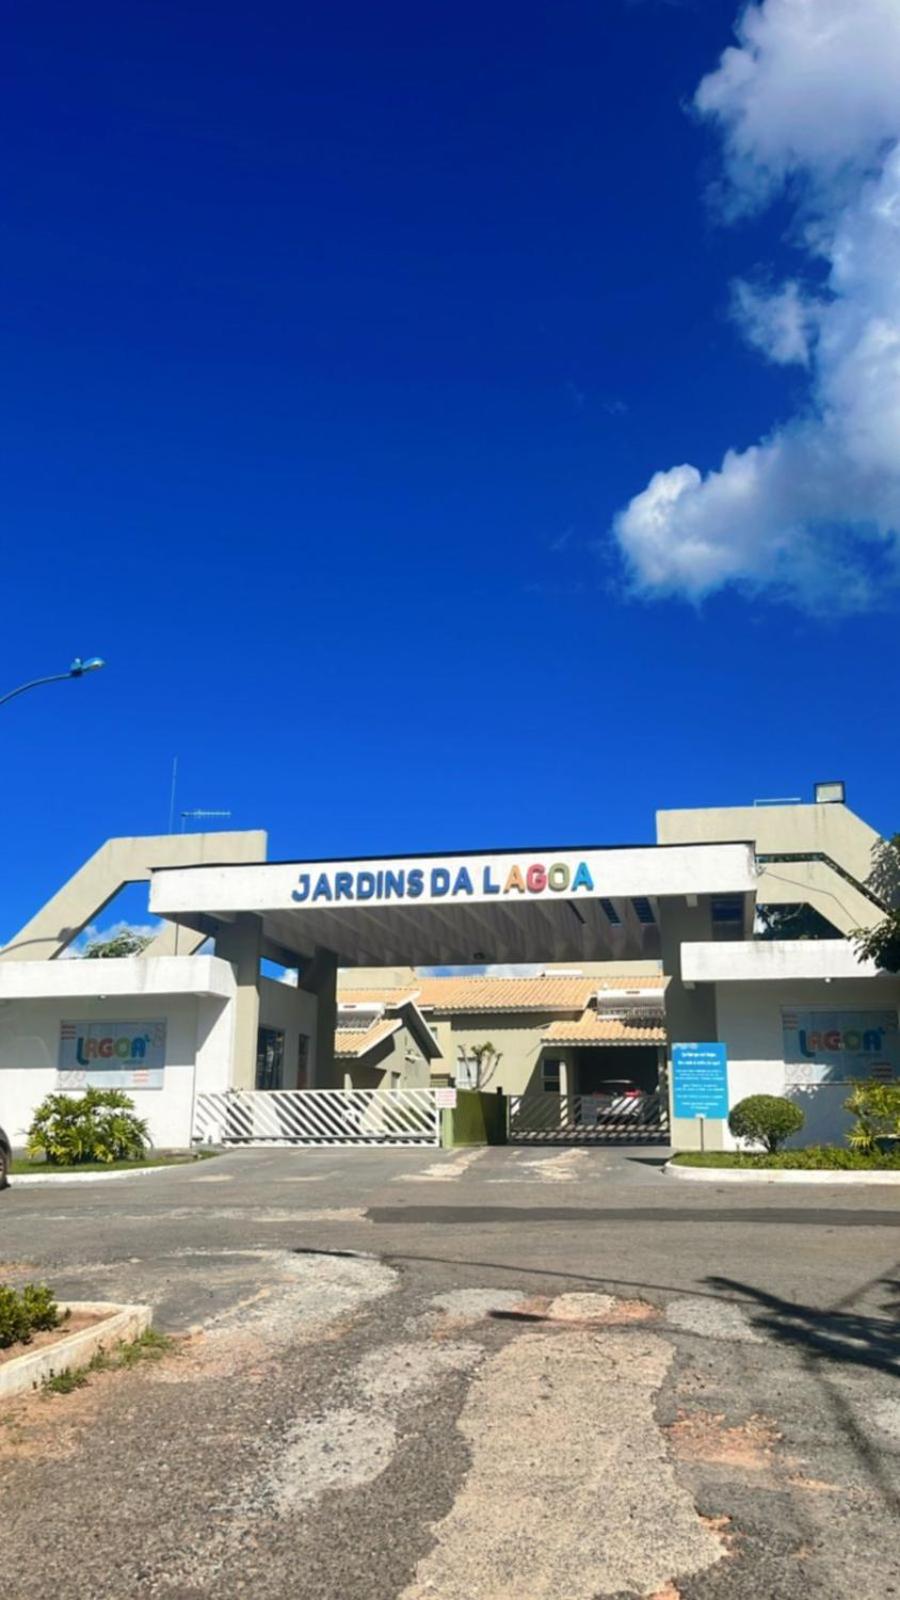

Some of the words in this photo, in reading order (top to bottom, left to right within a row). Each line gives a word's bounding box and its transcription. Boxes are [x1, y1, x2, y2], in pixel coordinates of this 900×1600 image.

[291, 868, 424, 902] JARDINS
[431, 866, 473, 897] DA
[483, 861, 594, 894] LAGOA
[76, 1035, 147, 1065] LAGOA
[798, 1028, 882, 1058] LAGOA
